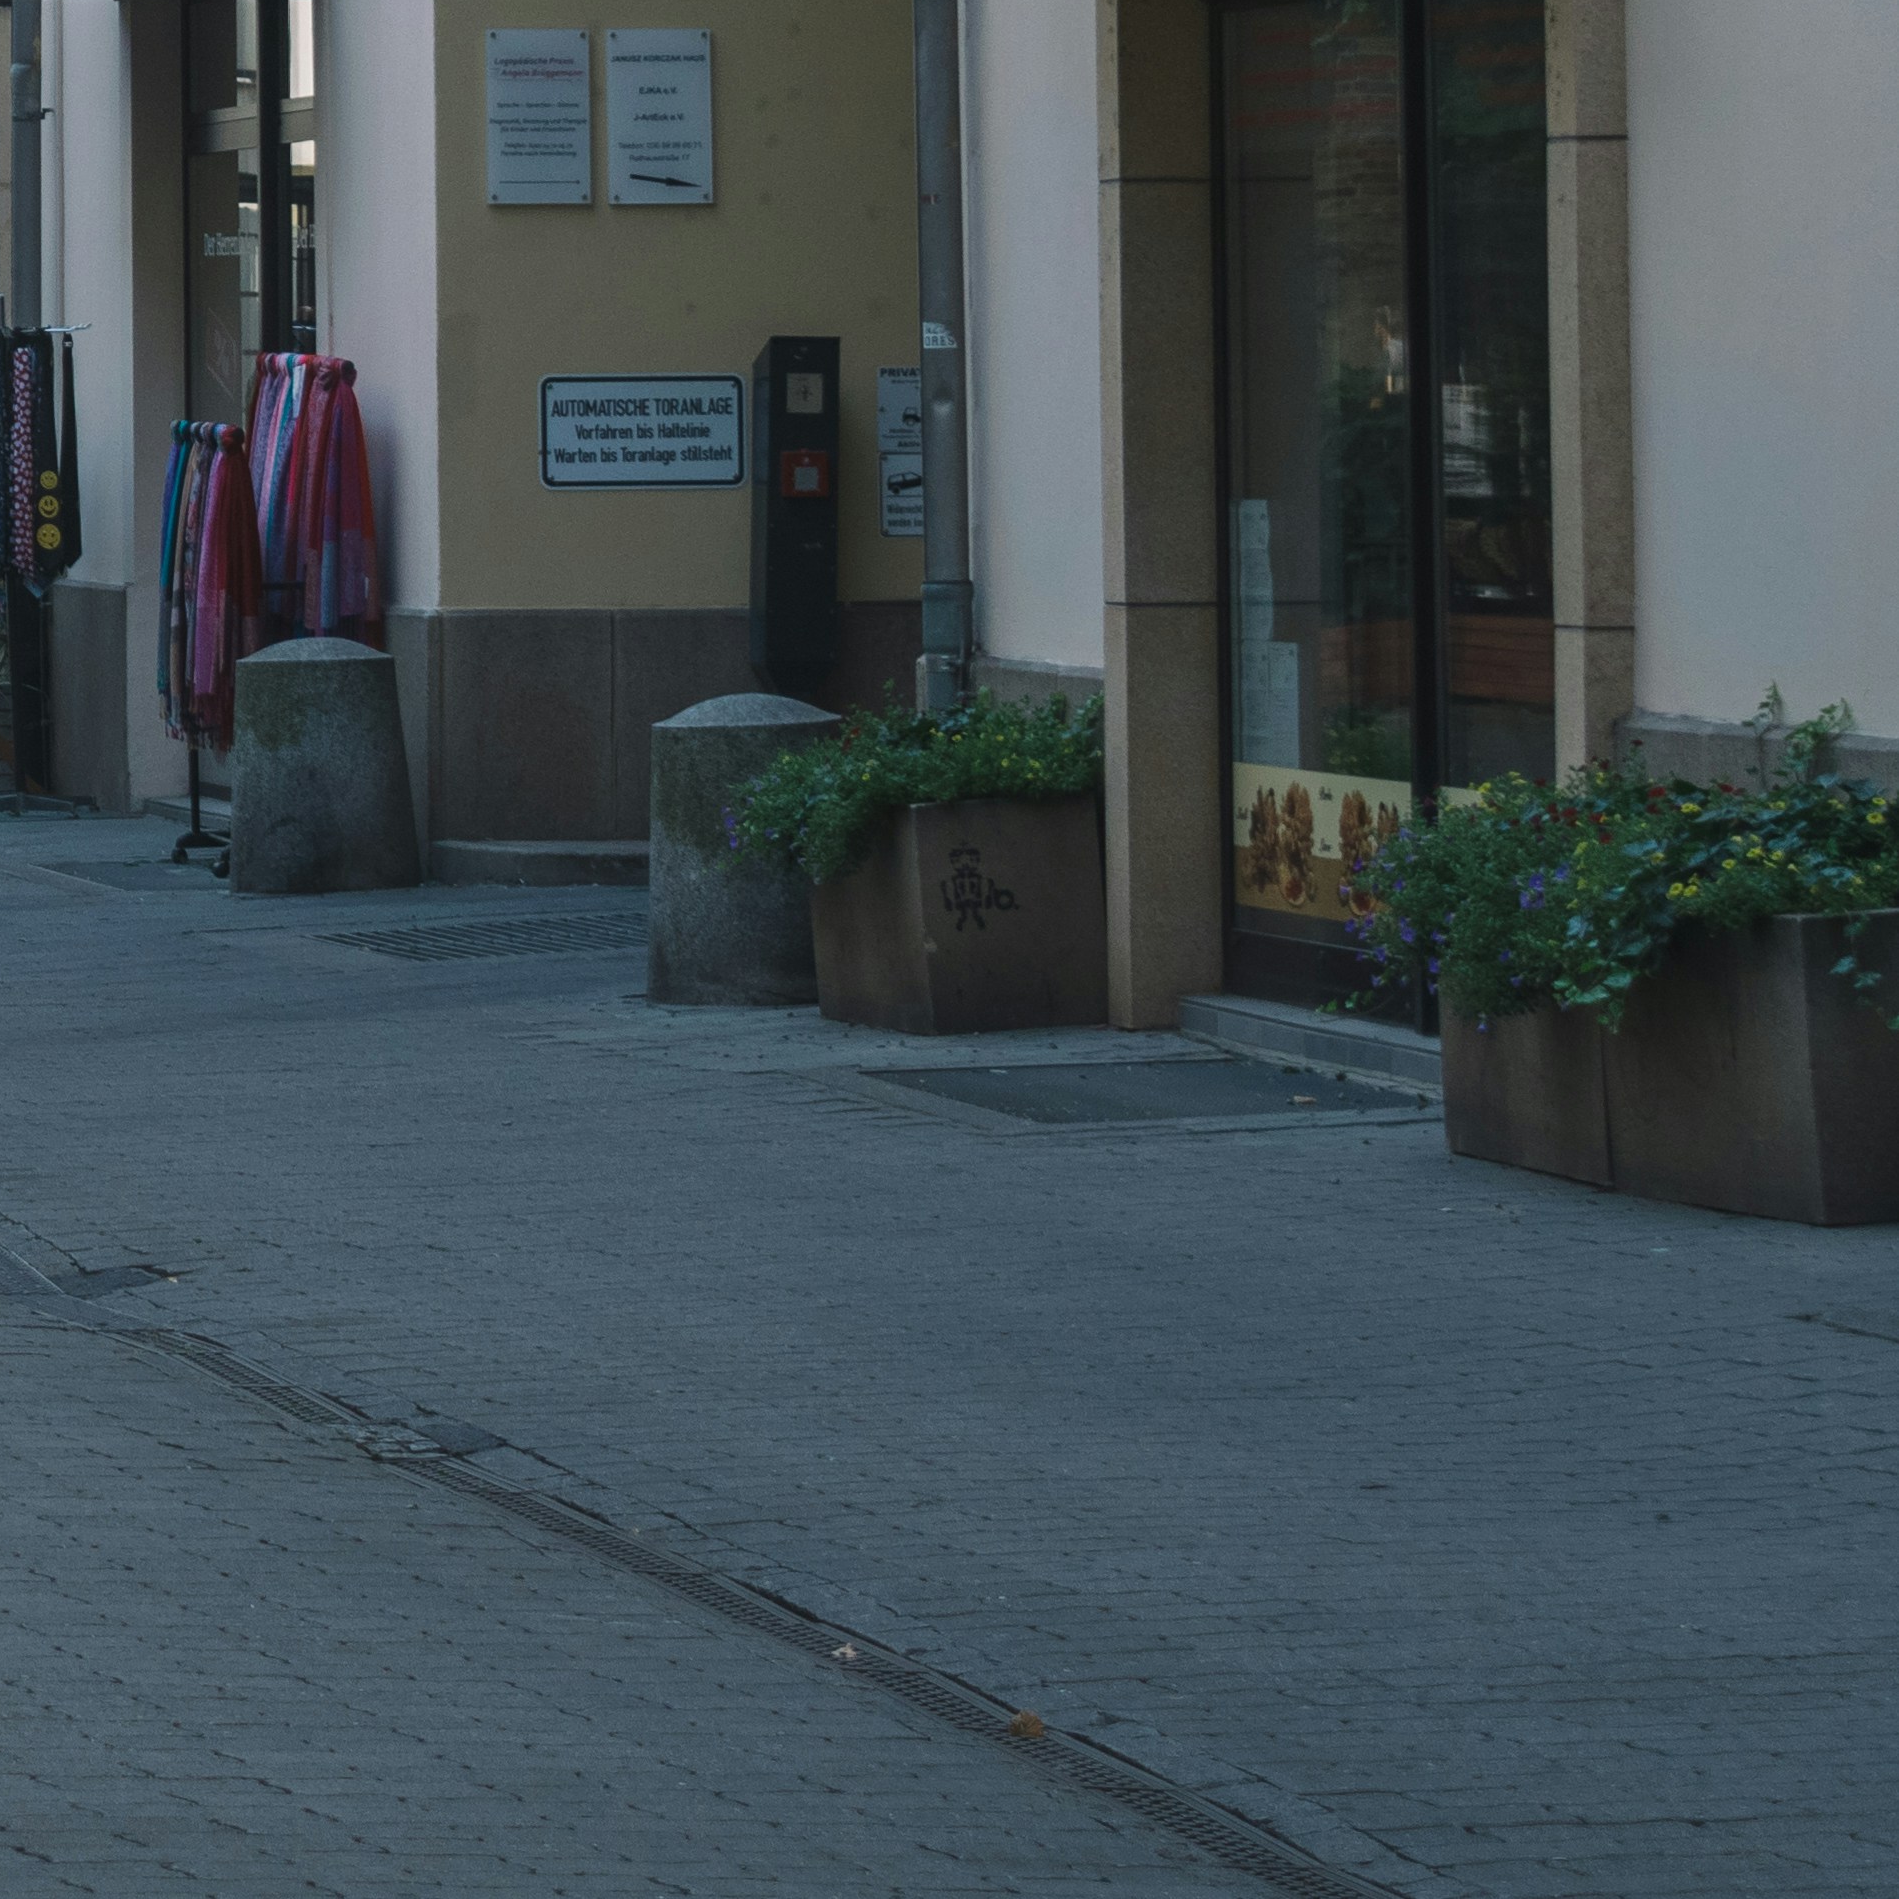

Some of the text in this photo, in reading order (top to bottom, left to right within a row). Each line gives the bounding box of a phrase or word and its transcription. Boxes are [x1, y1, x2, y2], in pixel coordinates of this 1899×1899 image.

[880, 367, 920, 377] PRIVA
[551, 397, 733, 417] AUTOMATISCHE TORANLAGE
[575, 422, 710, 440] Vorfahren bis Haltelinie
[554, 445, 732, 465] Warten bis Toranlage stillsteht
